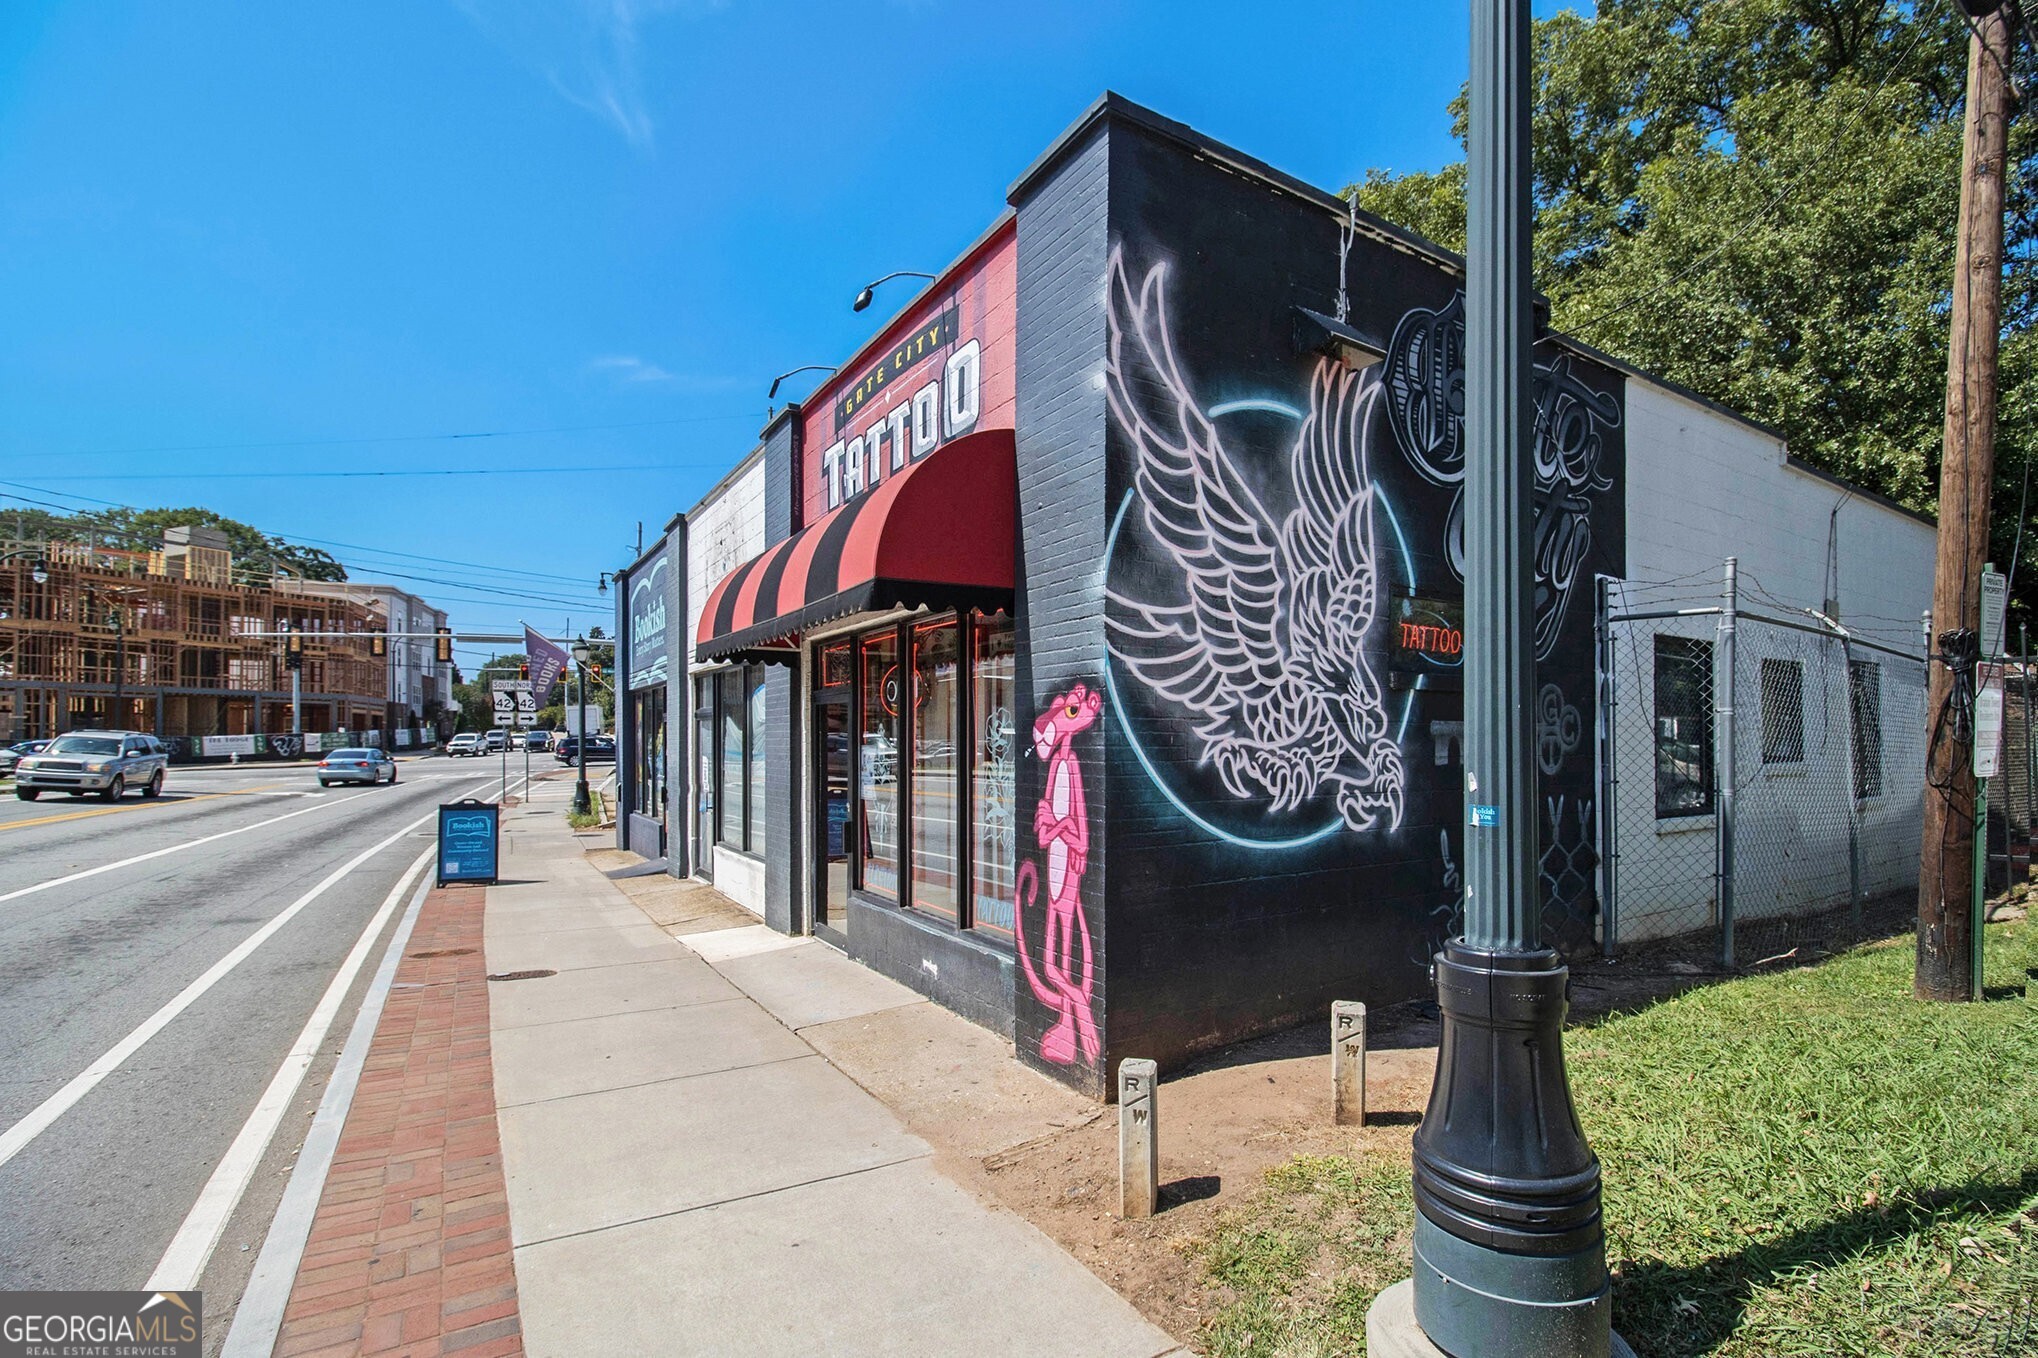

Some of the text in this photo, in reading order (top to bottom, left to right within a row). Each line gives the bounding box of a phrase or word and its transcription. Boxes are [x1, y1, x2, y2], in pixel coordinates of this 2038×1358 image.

[845, 326, 940, 414] GATE CITY
[822, 337, 982, 511] TATTOO
[634, 594, 666, 643] Bookish
[1400, 623, 1461, 653] TATTOO
[536, 657, 560, 693] BOOKS
[493, 681, 515, 689] SOUTH
[516, 681, 532, 689] NOR
[496, 699, 511, 708] 42
[520, 699, 535, 708] 42
[452, 821, 485, 830] Bookish
